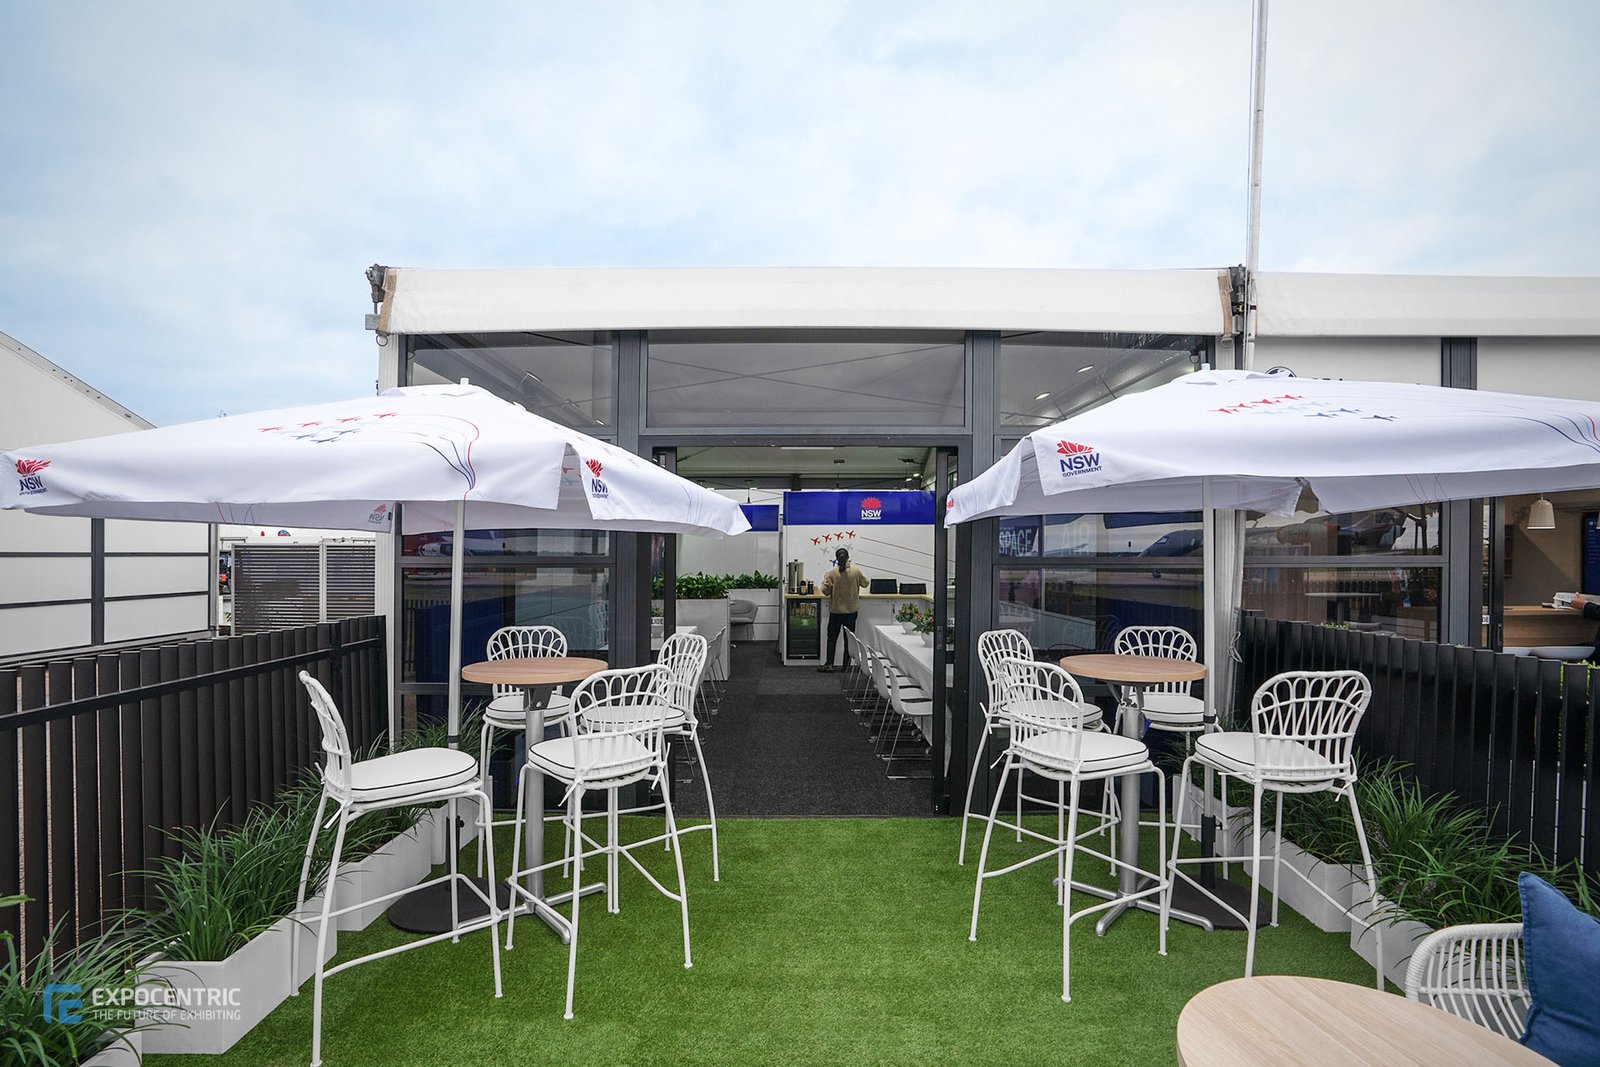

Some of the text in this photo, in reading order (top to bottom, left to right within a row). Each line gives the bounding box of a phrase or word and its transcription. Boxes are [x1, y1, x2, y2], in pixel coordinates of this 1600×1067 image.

[1060, 453, 1099, 472] NSW
[1062, 465, 1102, 477] GOVERNMENT
[19, 475, 43, 491] NSW
[998, 528, 1032, 556] SPACE
